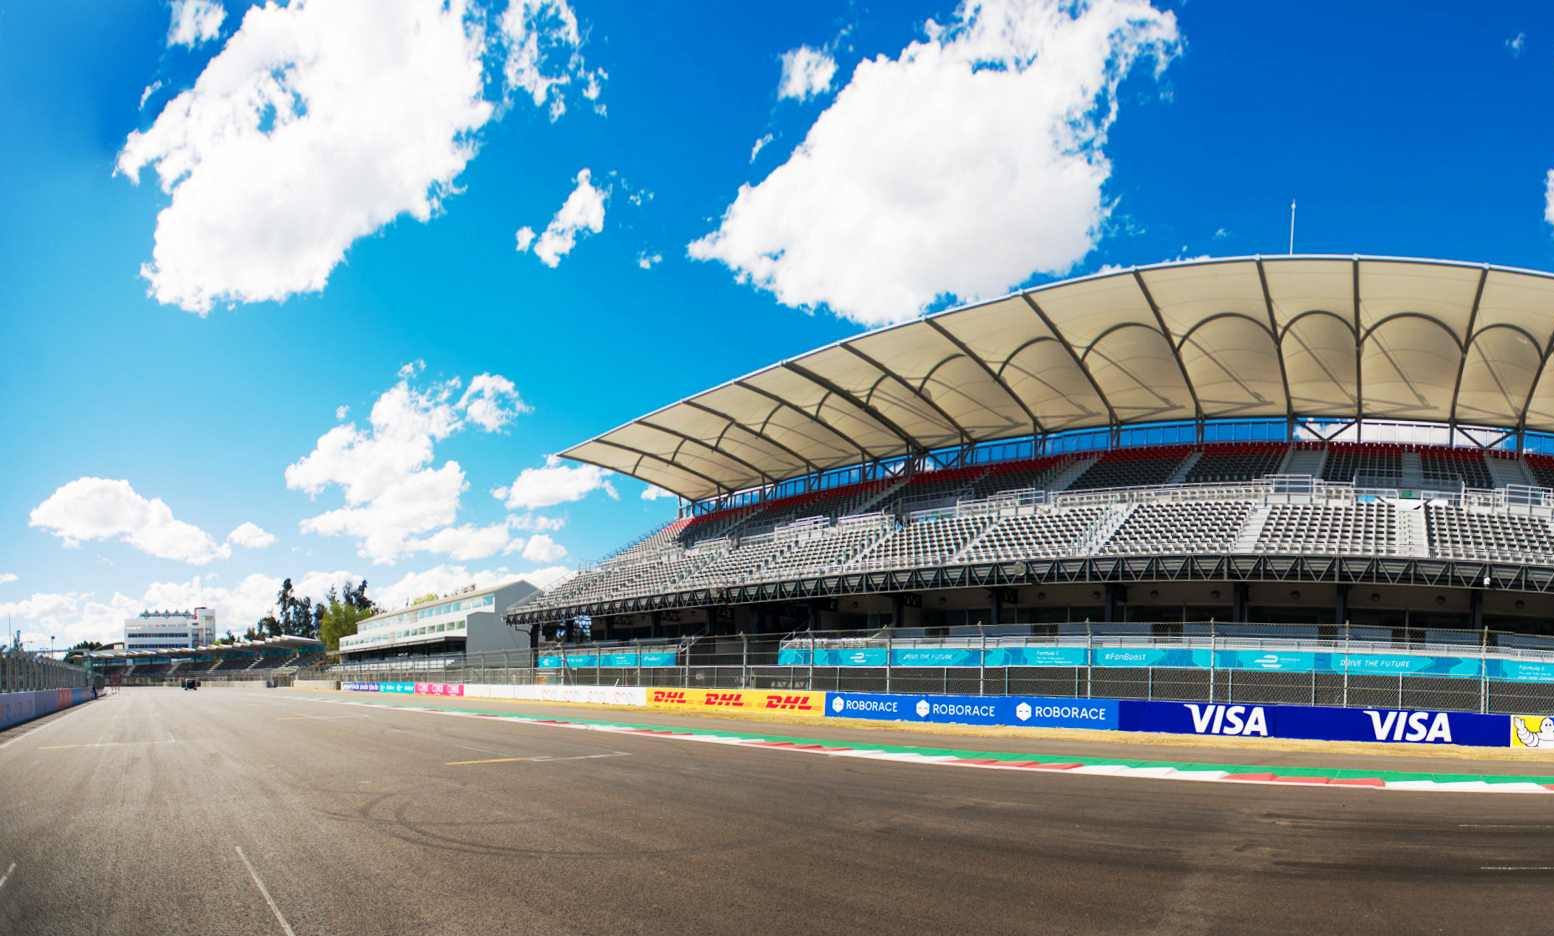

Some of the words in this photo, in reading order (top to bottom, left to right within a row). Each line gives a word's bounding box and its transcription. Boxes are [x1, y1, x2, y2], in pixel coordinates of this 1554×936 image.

[1105, 652, 1146, 661] #FanBoost
[1340, 659, 1362, 667] DRIVE
[1380, 660, 1411, 668] FUTURE
[653, 691, 687, 704] DHL
[705, 693, 744, 707] DHL
[765, 695, 812, 711] DHL
[846, 700, 898, 712] ROBORACE
[933, 704, 995, 717] ROBORACE
[1035, 707, 1106, 721] ROBORACE
[1184, 704, 1269, 737] VISA
[1363, 711, 1452, 743] VISA
